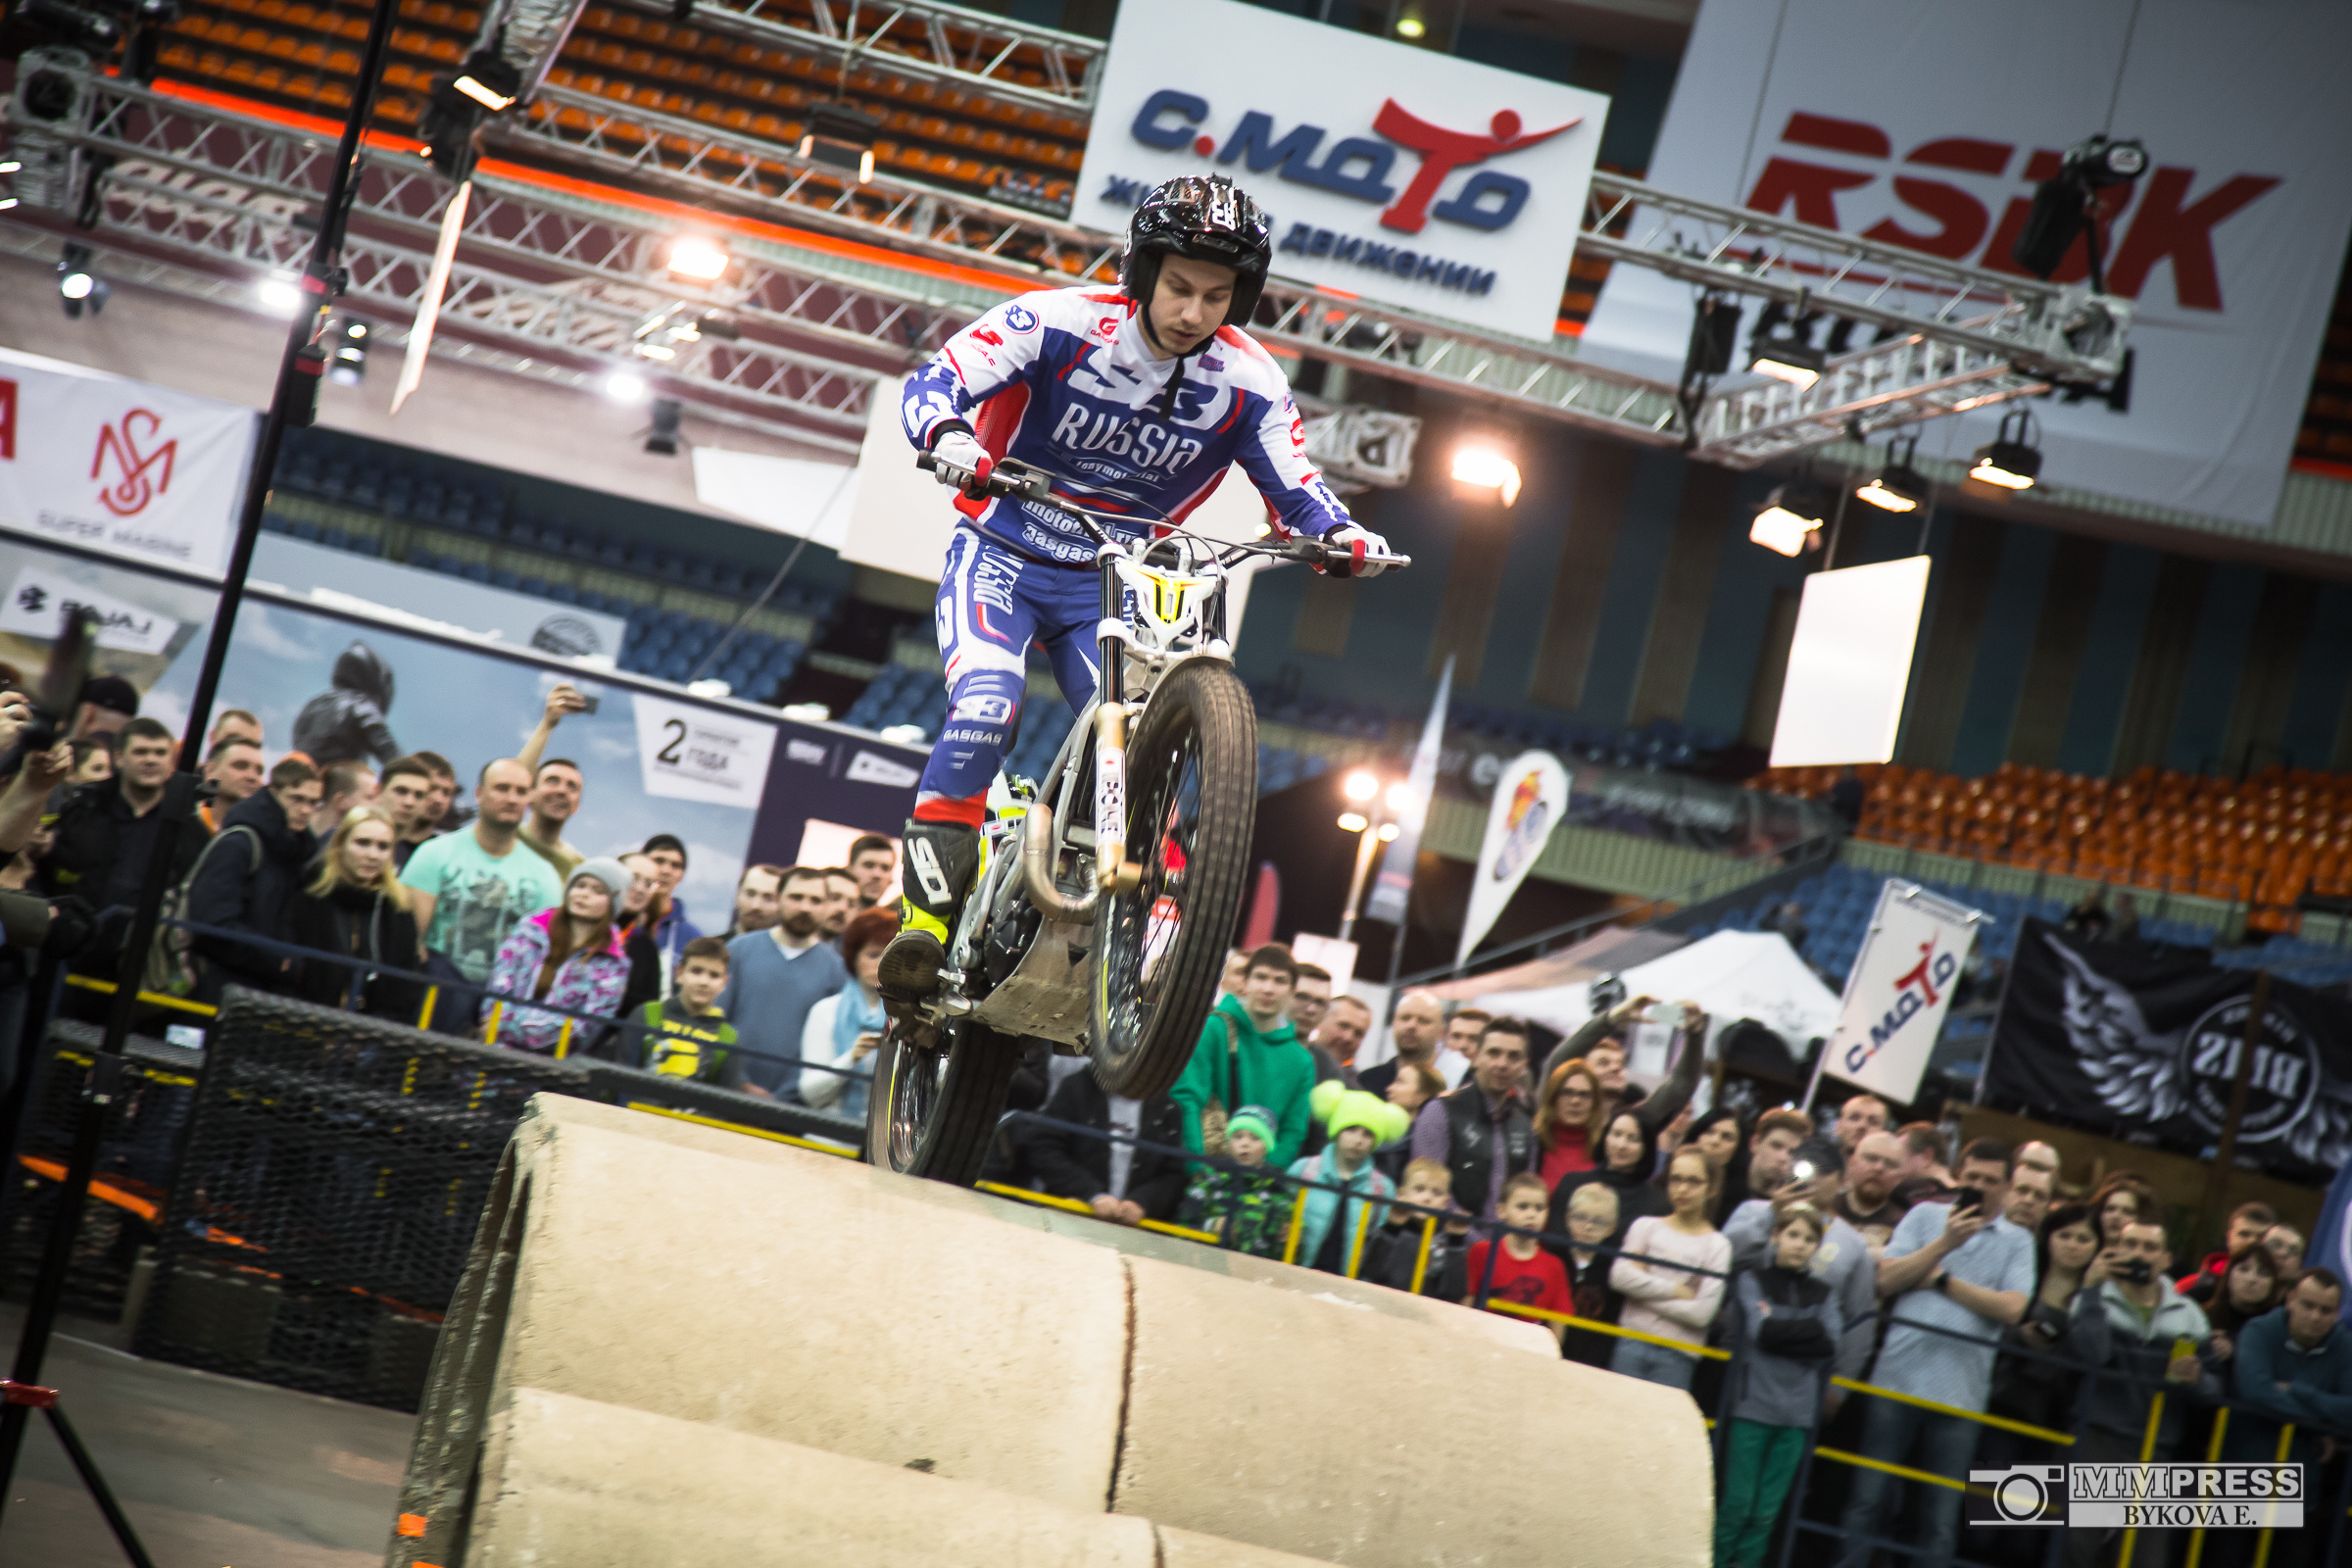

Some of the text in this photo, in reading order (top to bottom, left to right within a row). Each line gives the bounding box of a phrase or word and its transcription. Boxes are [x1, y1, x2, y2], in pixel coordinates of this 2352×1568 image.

[1051, 402, 1203, 475] RUSSIA
[657, 718, 687, 764] 2
[942, 729, 1004, 746] GASGAS
